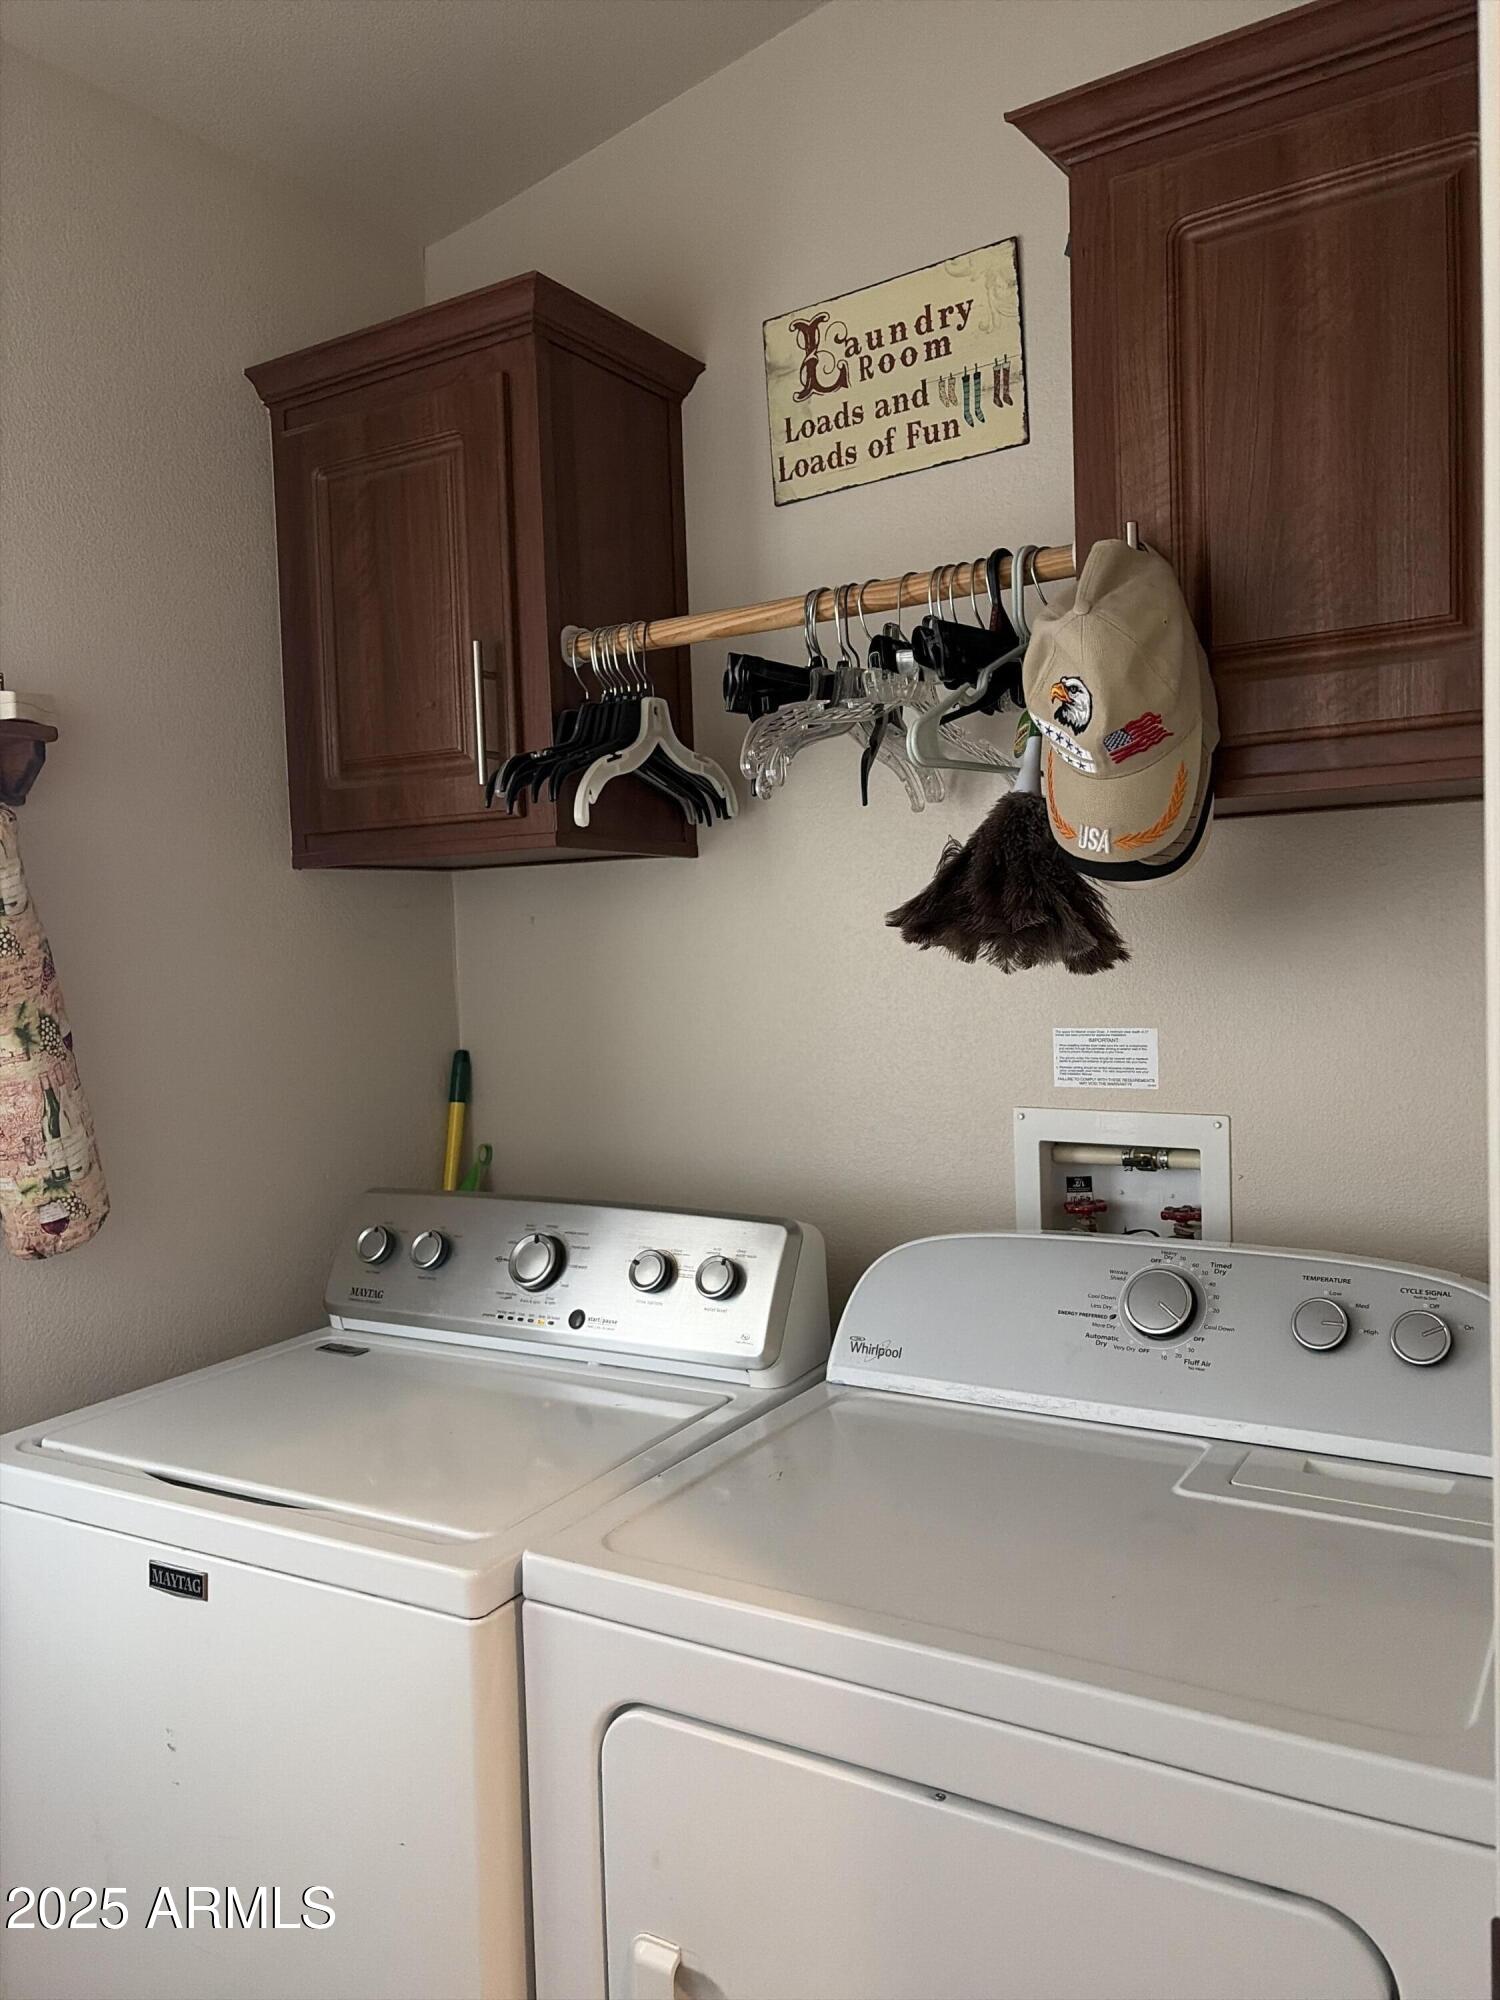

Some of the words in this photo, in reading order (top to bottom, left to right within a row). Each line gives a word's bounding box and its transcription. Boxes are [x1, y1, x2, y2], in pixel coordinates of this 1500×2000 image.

[789, 299, 974, 402] Laundry
[784, 402, 864, 444] Loads
[874, 378, 930, 419] and
[778, 441, 858, 482] Loads
[868, 427, 896, 458] of
[906, 418, 961, 450] Fun
[1078, 824, 1110, 854] USA
[1303, 1275, 1351, 1284] TEMPERATURE
[350, 1287, 384, 1299] MAYTAG
[1085, 1332, 1119, 1341] Automatic
[850, 1341, 902, 1359] Whirlpool
[152, 1568, 201, 1593] MAYTAG
